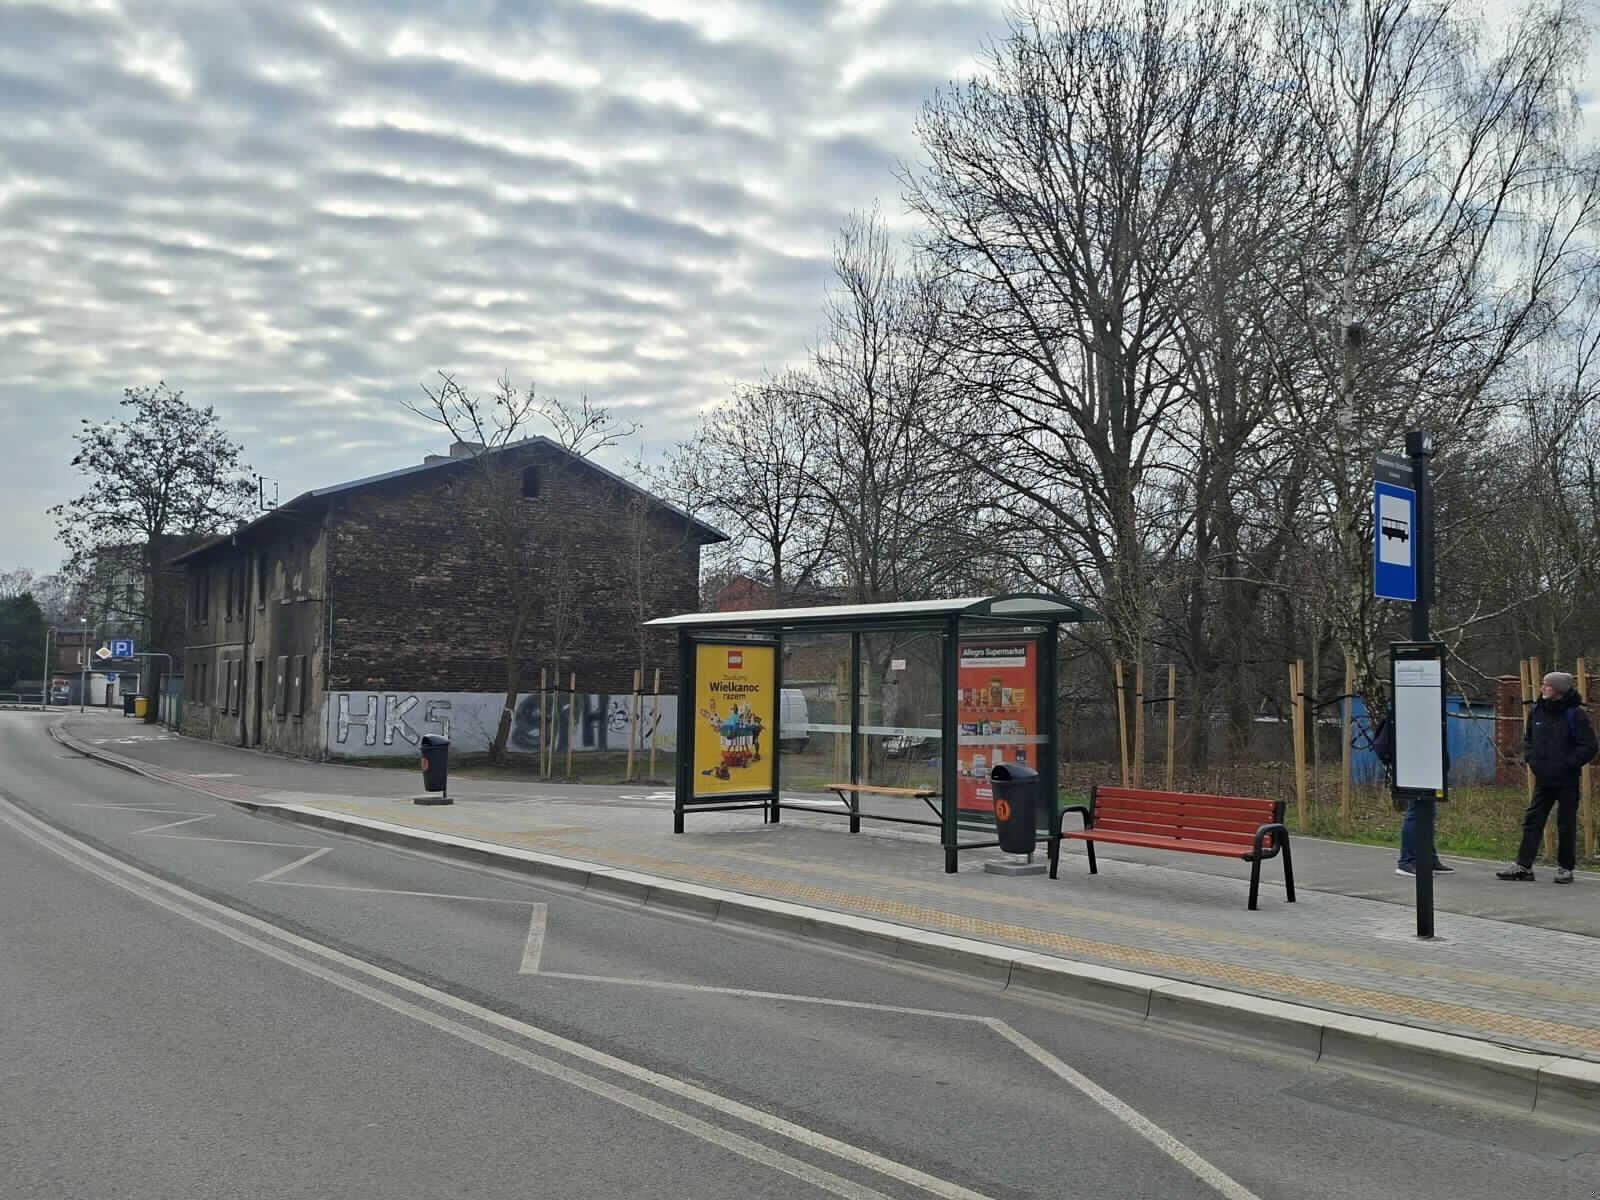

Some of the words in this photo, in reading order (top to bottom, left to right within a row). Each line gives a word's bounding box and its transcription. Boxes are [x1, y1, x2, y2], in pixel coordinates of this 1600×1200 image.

[116, 642, 127, 655] P
[963, 648, 985, 657] Allegro
[985, 647, 1025, 657] Supermarket
[710, 681, 760, 692] Wielkanoc
